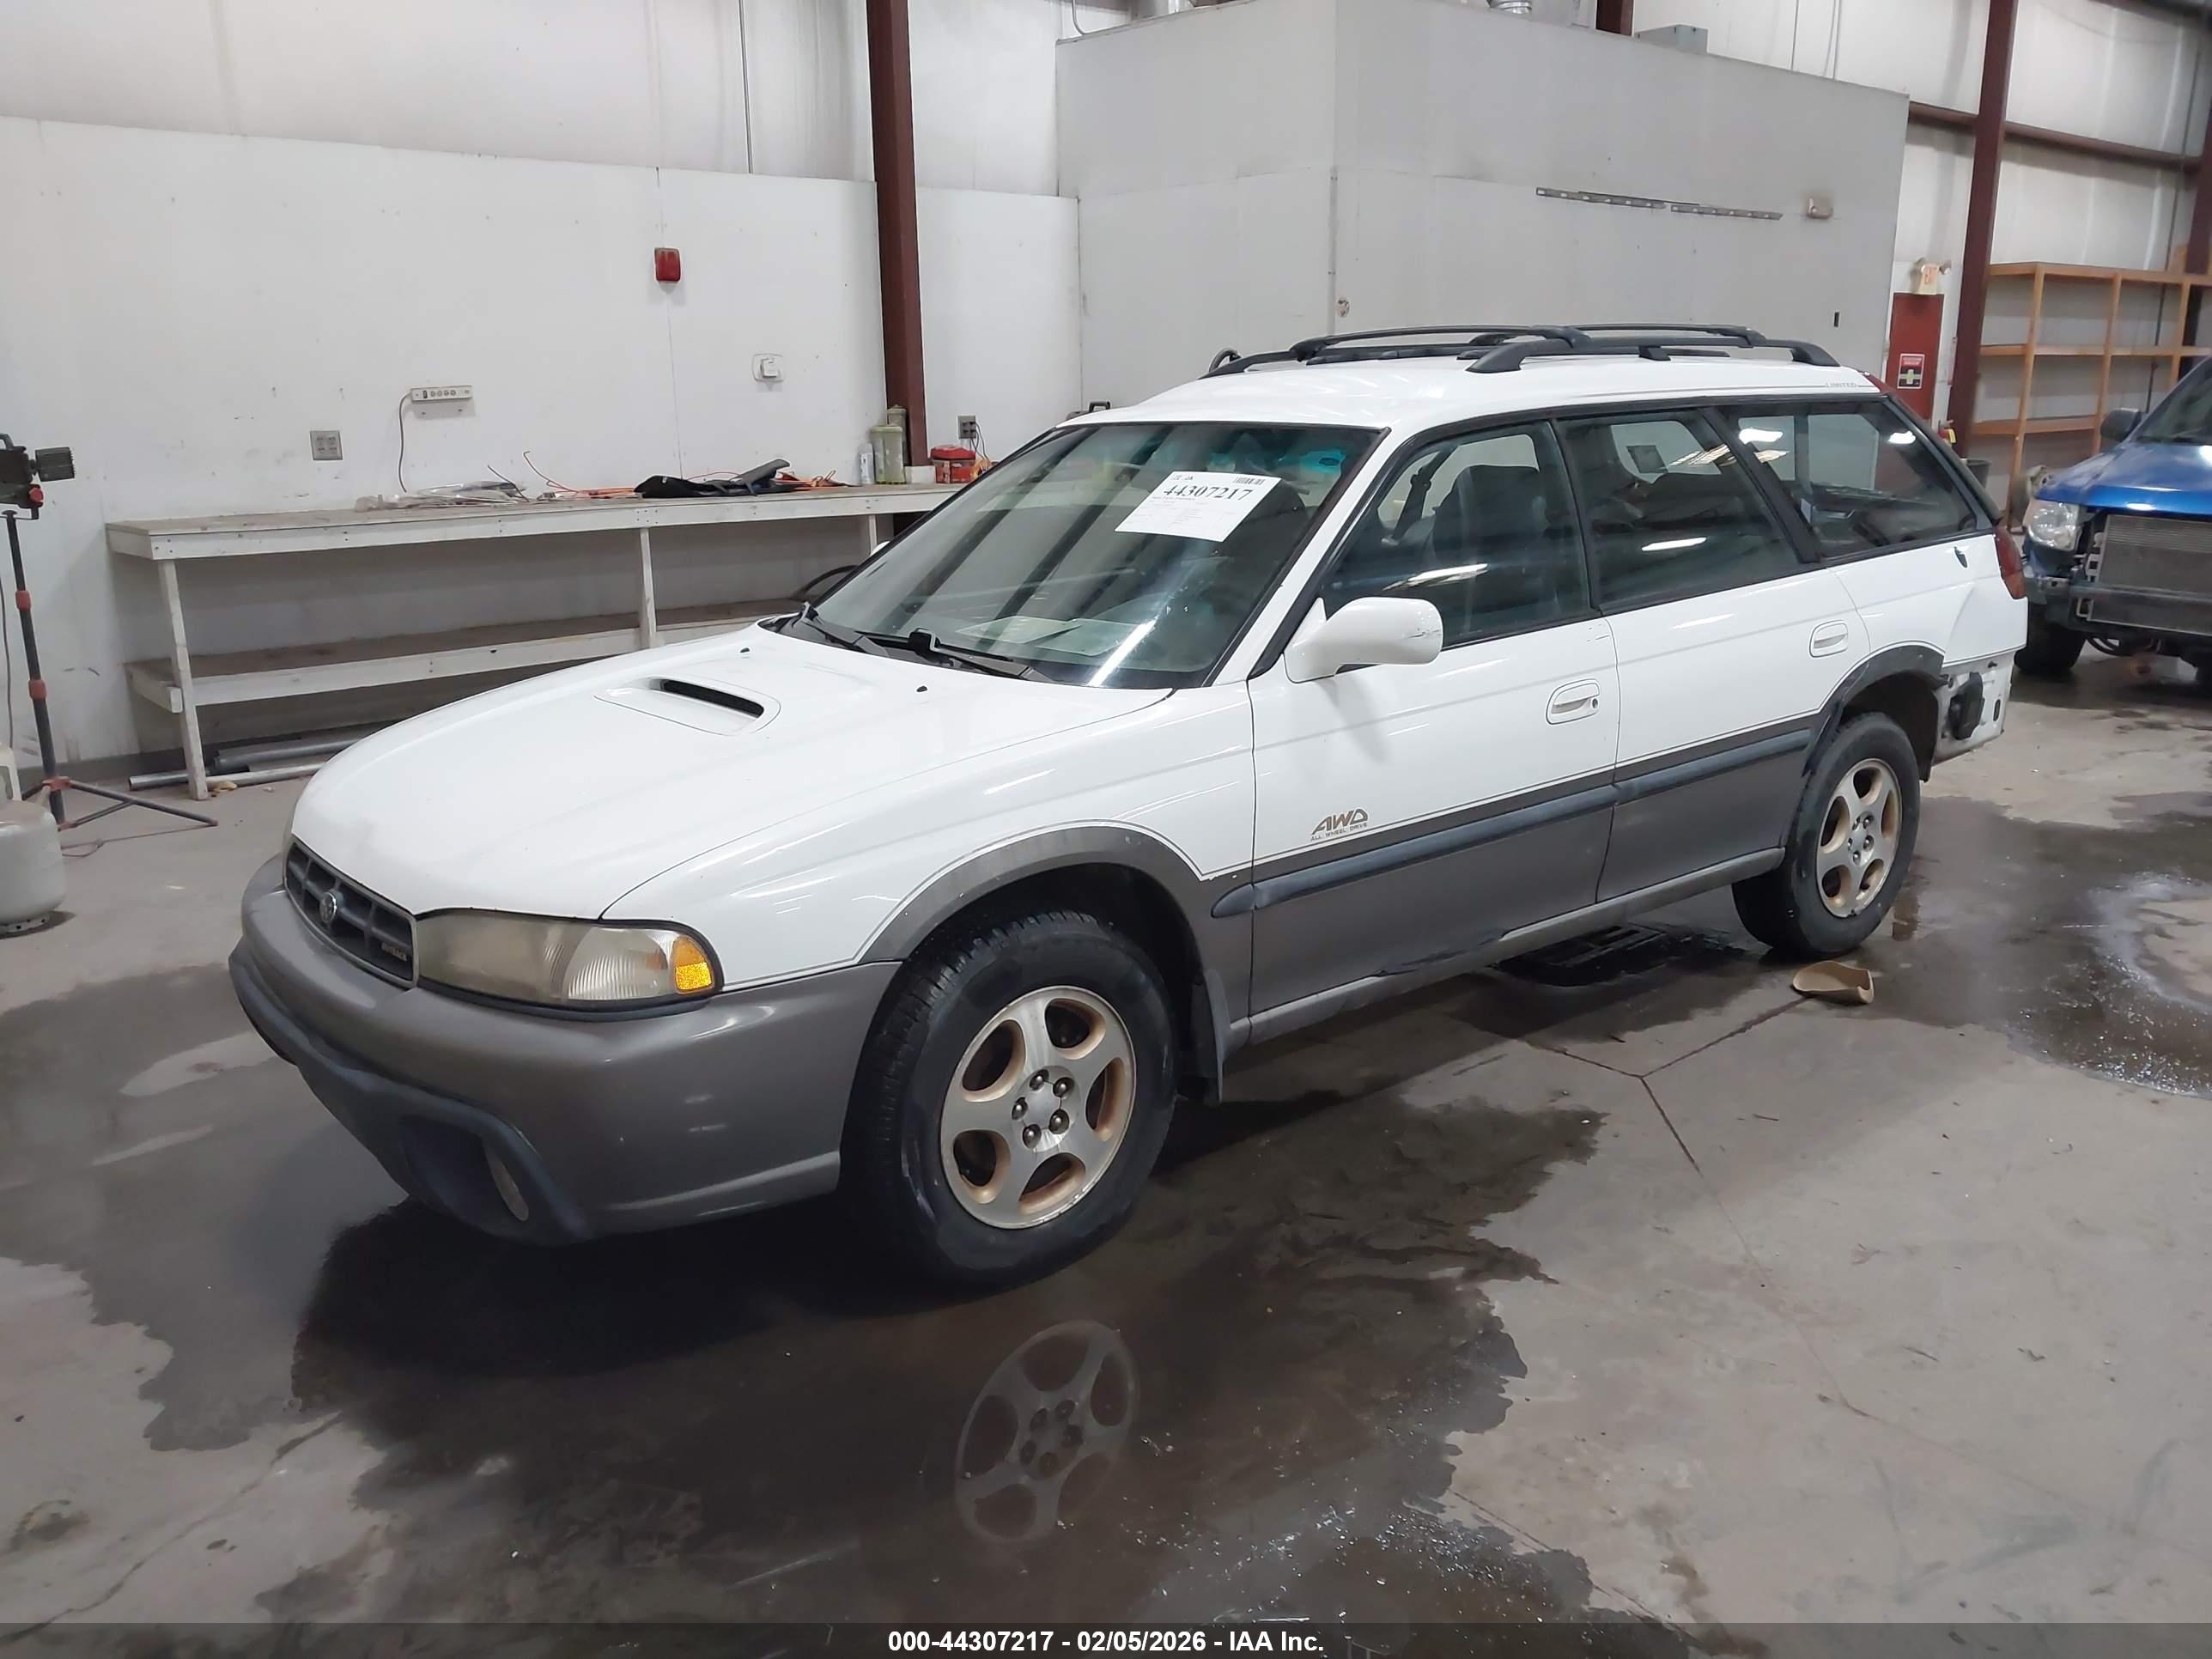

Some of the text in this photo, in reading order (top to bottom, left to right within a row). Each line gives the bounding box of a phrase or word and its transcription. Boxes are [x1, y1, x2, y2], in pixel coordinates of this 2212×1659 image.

[1163, 484, 1254, 501] 44307217
[1310, 808, 1369, 836] AWD
[1325, 829, 1346, 837] WHEEL
[1349, 822, 1368, 831] DRIVE
